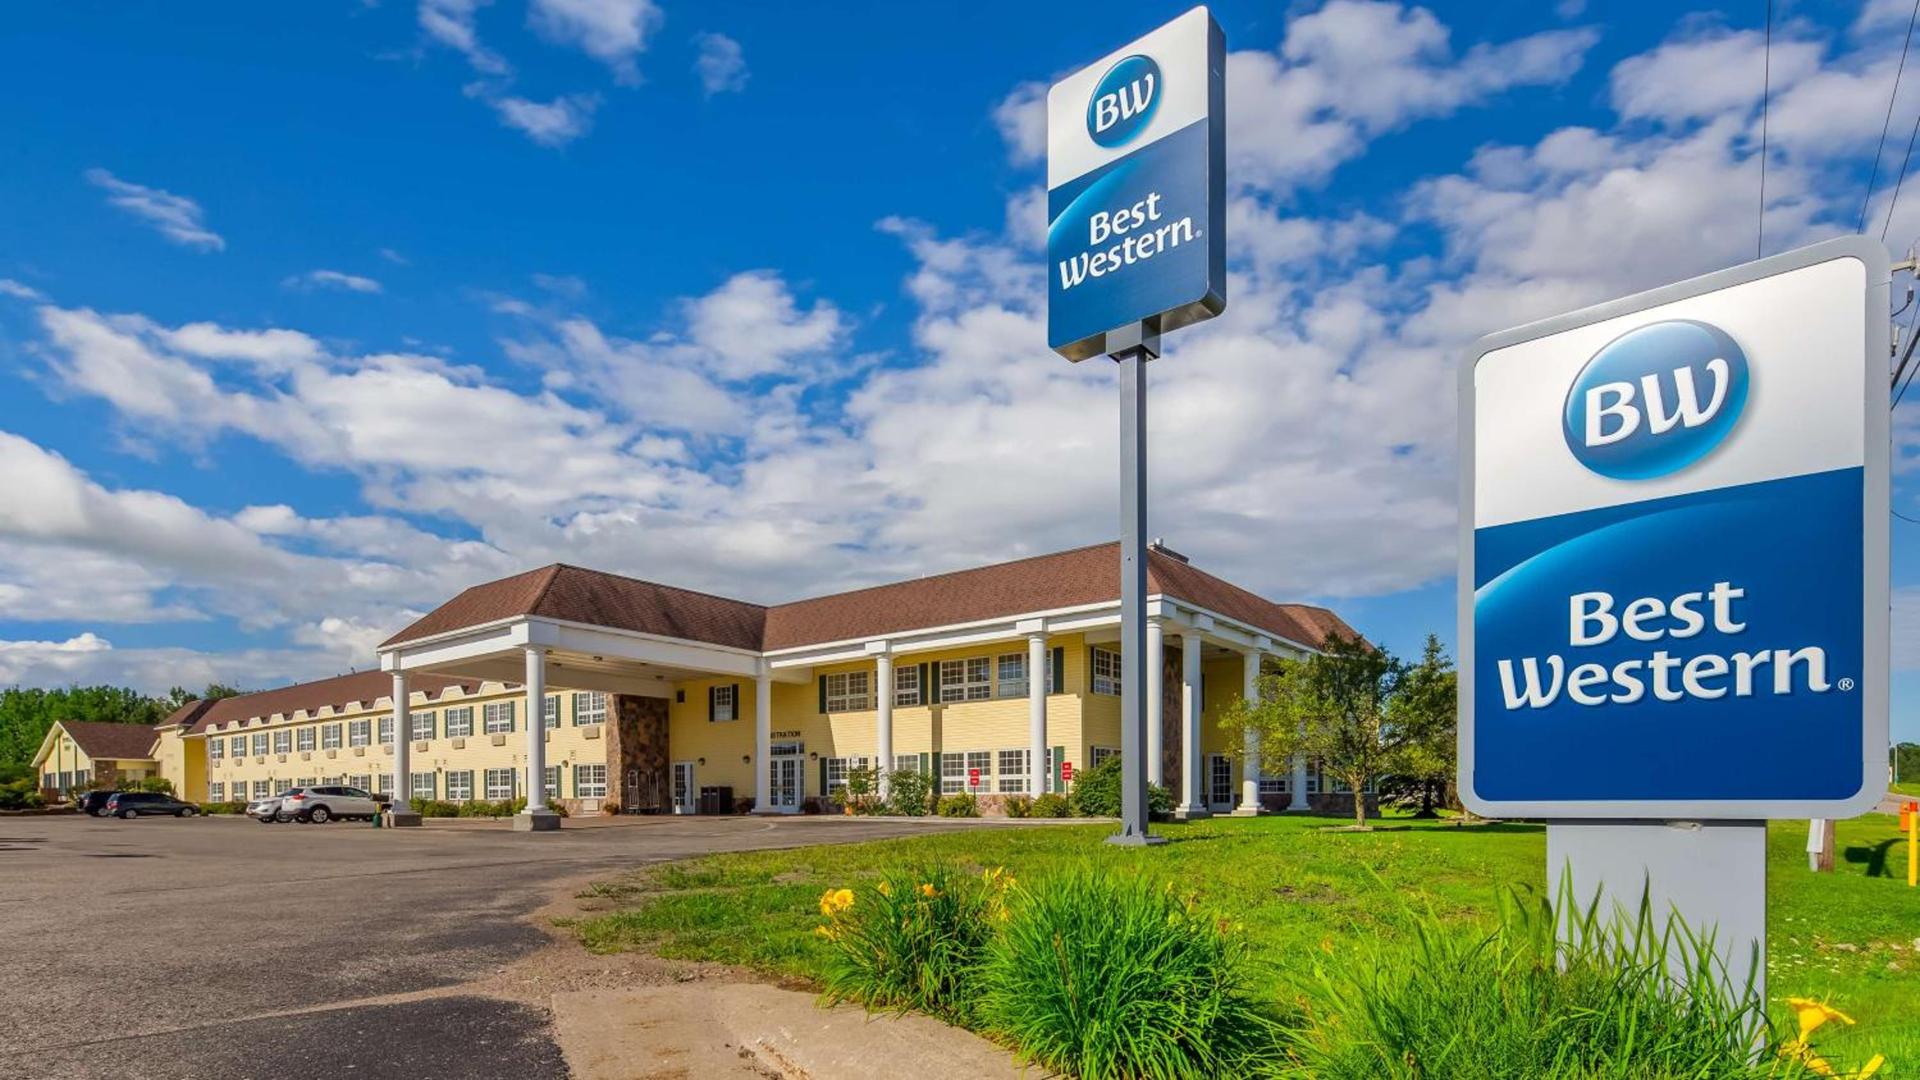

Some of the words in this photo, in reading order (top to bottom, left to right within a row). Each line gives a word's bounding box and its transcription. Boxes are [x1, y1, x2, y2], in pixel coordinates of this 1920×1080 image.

[1095, 73, 1155, 133] BW
[1089, 192, 1161, 246] Best
[1059, 216, 1193, 290] Western
[1586, 358, 1729, 447] BW
[1569, 581, 1747, 646] Best
